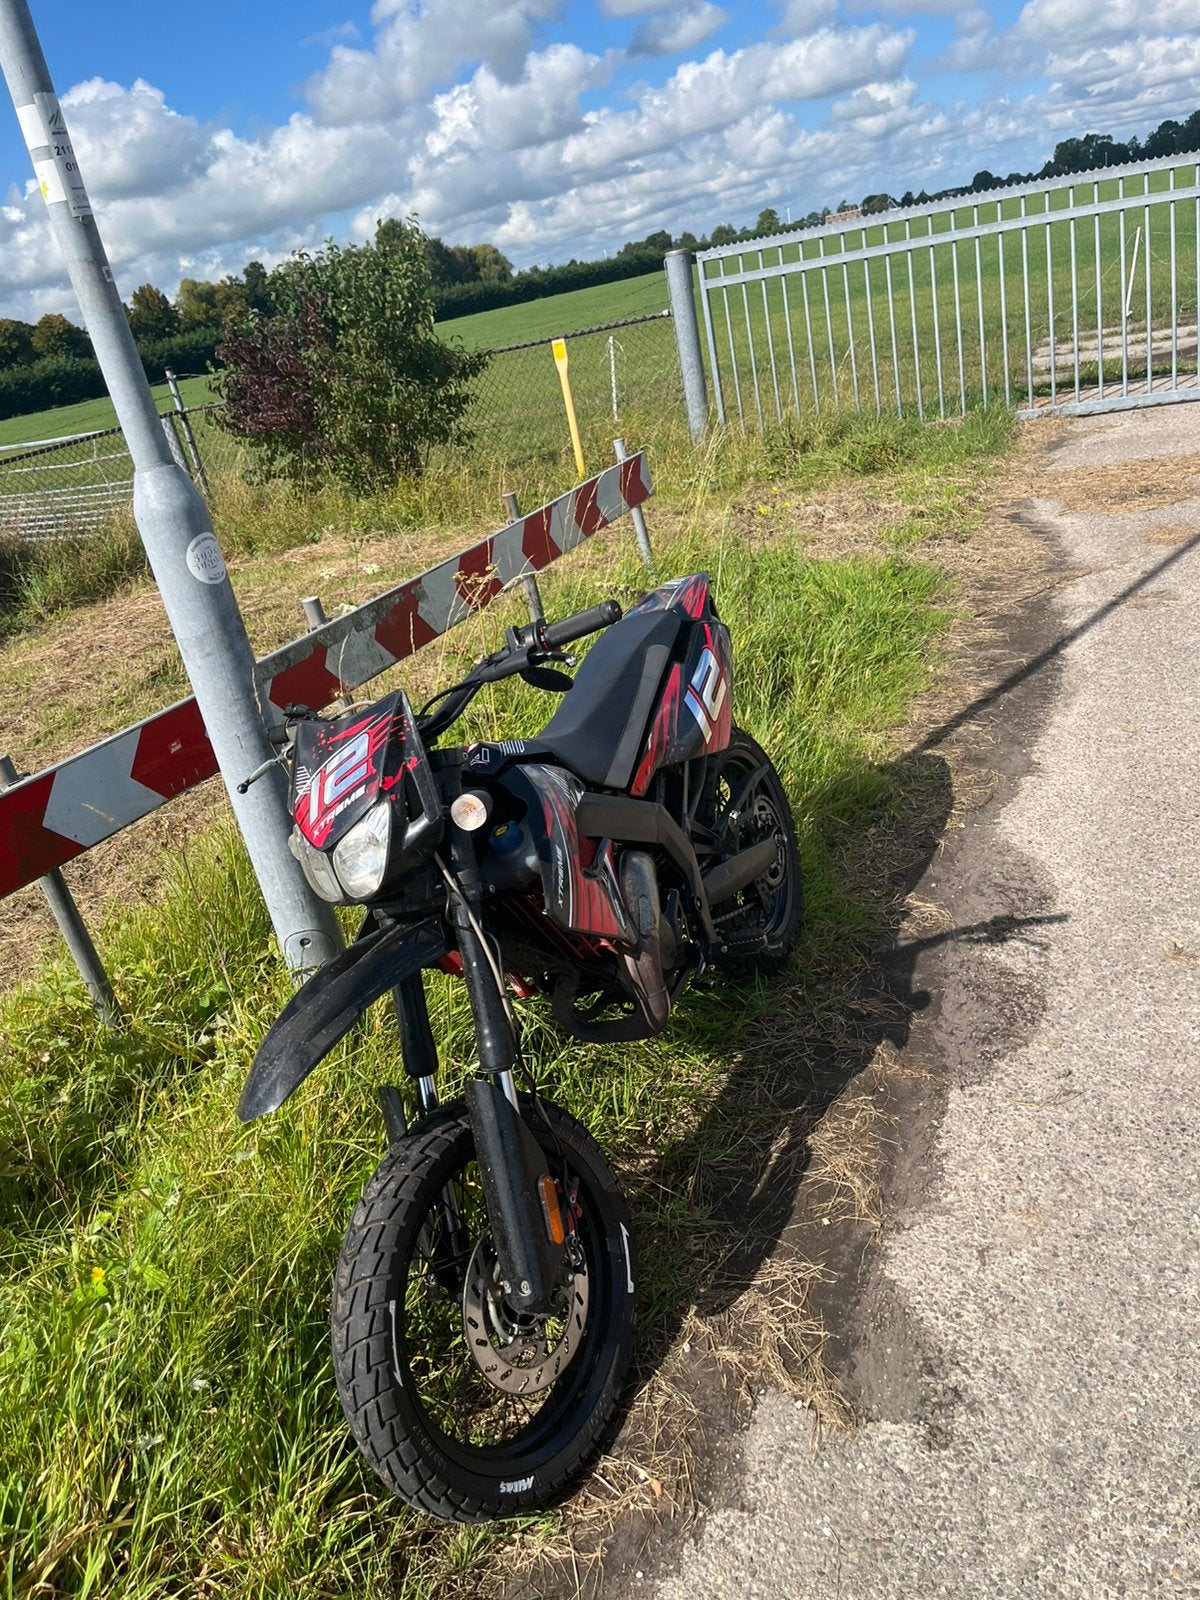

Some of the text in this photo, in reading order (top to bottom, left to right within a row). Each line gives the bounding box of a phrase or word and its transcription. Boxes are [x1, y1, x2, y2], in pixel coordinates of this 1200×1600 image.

[684, 647, 728, 745] 12
[309, 731, 370, 826] 12
[312, 784, 366, 841] XTREME
